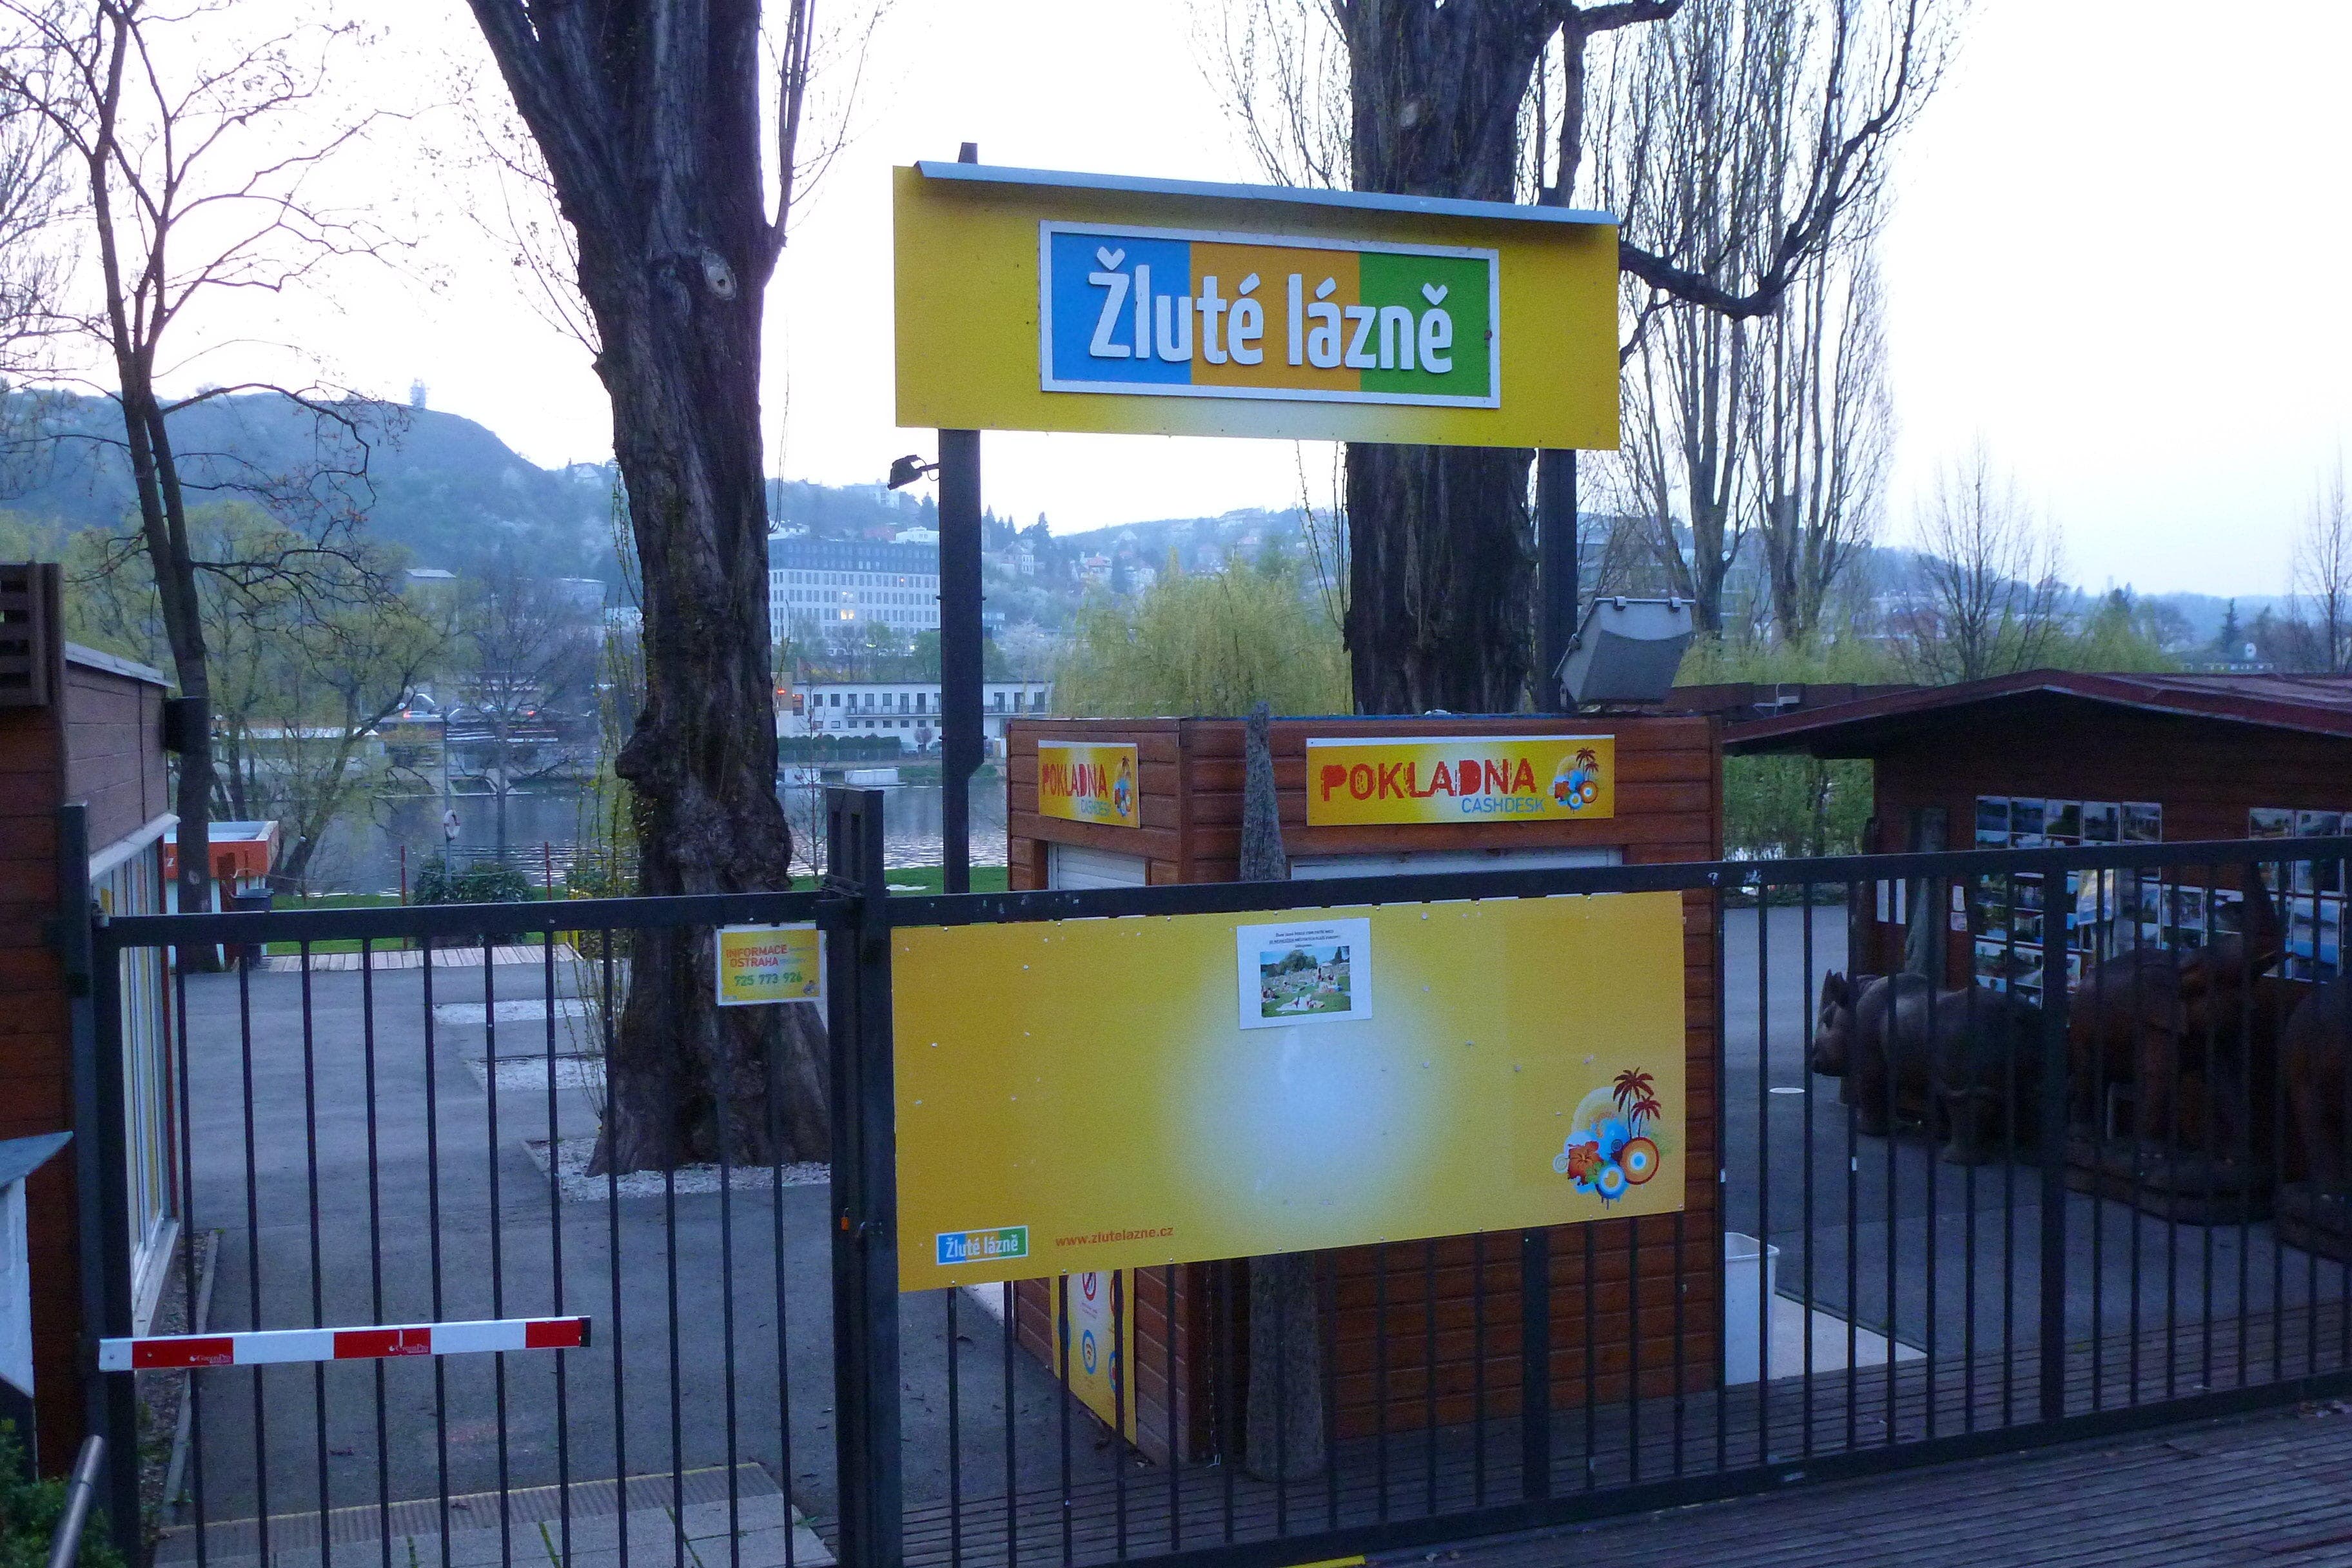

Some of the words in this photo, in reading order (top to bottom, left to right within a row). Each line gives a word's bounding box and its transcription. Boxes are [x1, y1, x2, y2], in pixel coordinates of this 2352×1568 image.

[1088, 246, 1264, 366] Žluté
[1287, 273, 1453, 373] lázně
[1042, 763, 1109, 798] POKLADNA
[1320, 758, 1538, 802] POKLADNA
[1461, 796, 1545, 814] CASHDESK
[726, 944, 788, 959] INFORMACE
[729, 956, 779, 968] OSTRAHA
[946, 1237, 981, 1258] Žluté
[984, 1234, 1018, 1254] lázně
[1055, 1228, 1173, 1246] www.zlutelazne.cz
